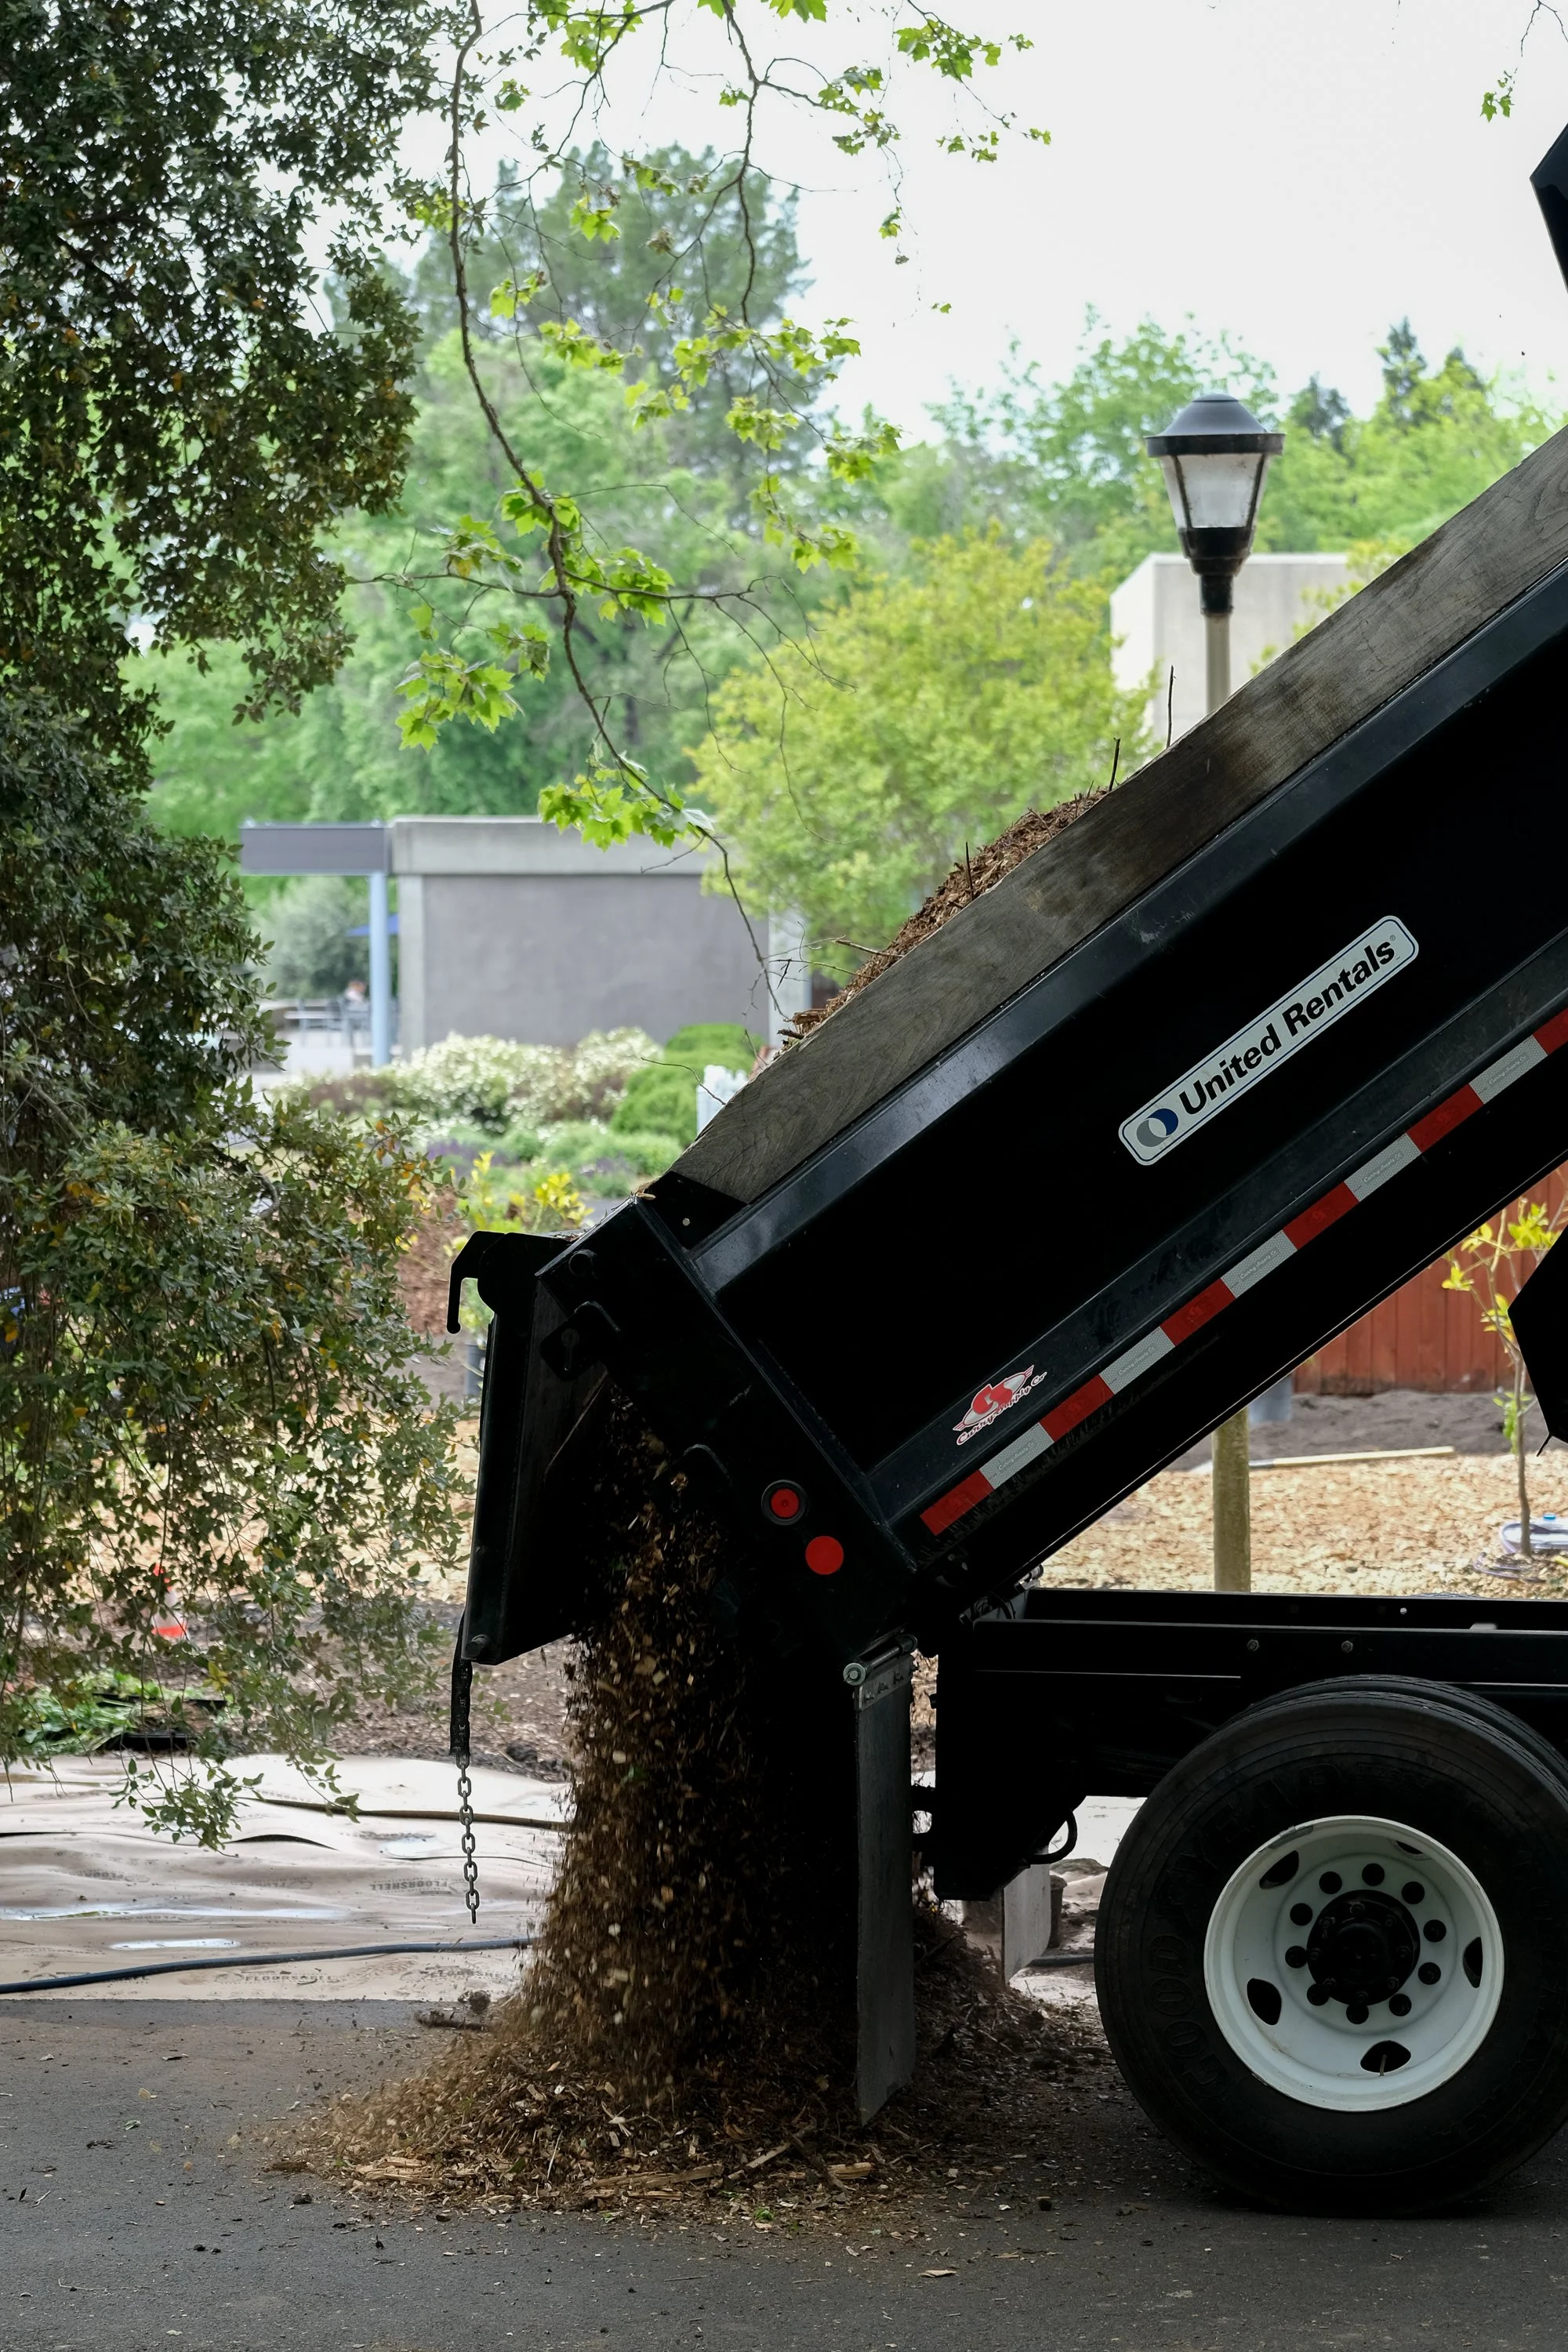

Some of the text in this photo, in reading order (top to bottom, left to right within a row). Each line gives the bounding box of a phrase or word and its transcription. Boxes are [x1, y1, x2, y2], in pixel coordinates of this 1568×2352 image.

[1179, 942, 1394, 1114] United Rentals
[370, 1880, 448, 1891] FLOORSHELL
[1149, 1762, 1342, 2097] GOODYEAR
